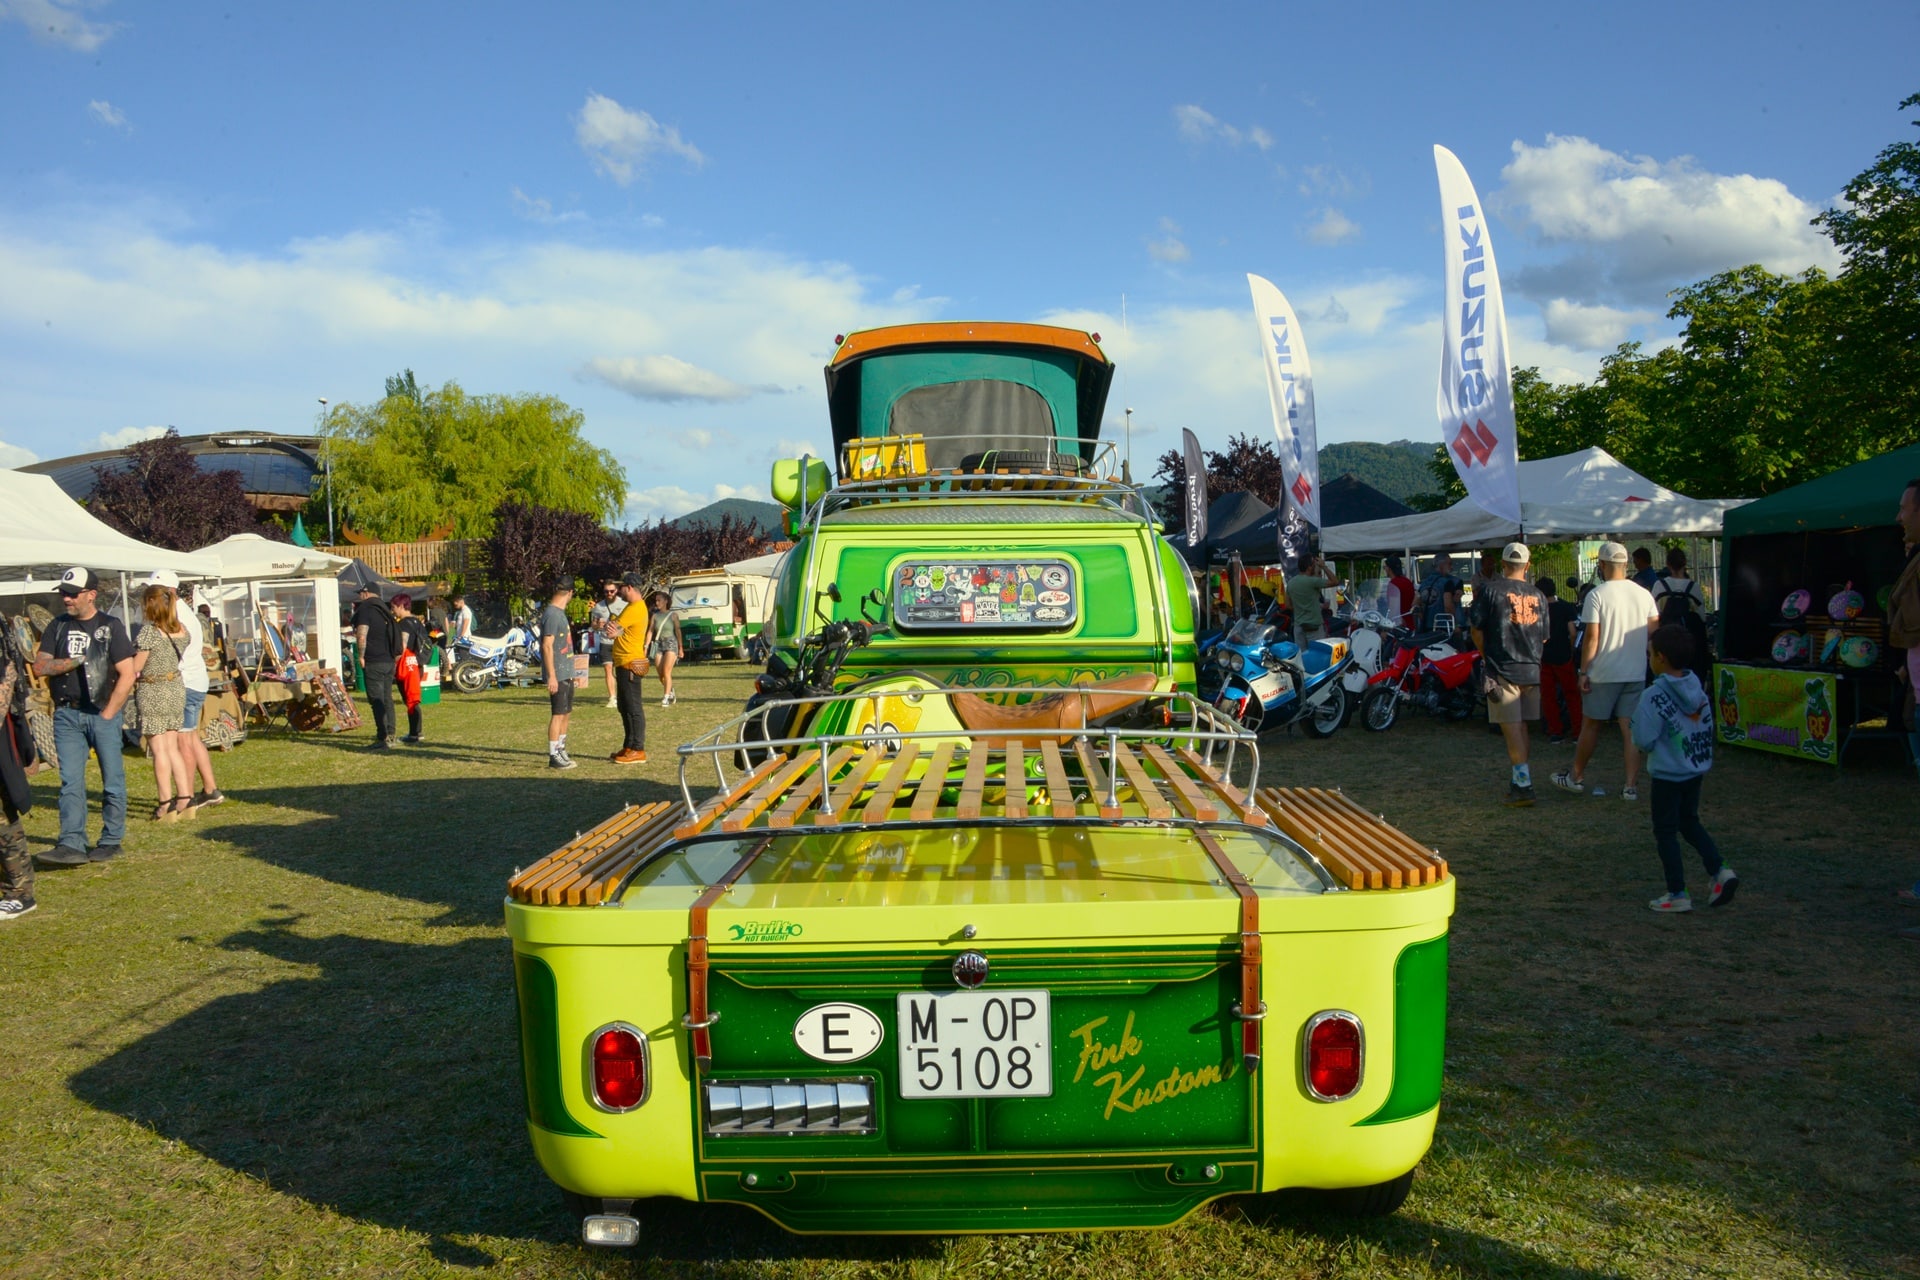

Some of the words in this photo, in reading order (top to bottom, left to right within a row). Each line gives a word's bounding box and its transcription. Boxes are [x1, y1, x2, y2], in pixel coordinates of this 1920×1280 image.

[1335, 645, 1345, 660] 34
[1261, 685, 1289, 700] SUZUKI
[744, 920, 791, 935] Built
[760, 934, 790, 942] BOUGHT
[821, 1012, 854, 1055] E
[1069, 1009, 1144, 1084] Fink
[917, 1045, 1033, 1091] 5108
